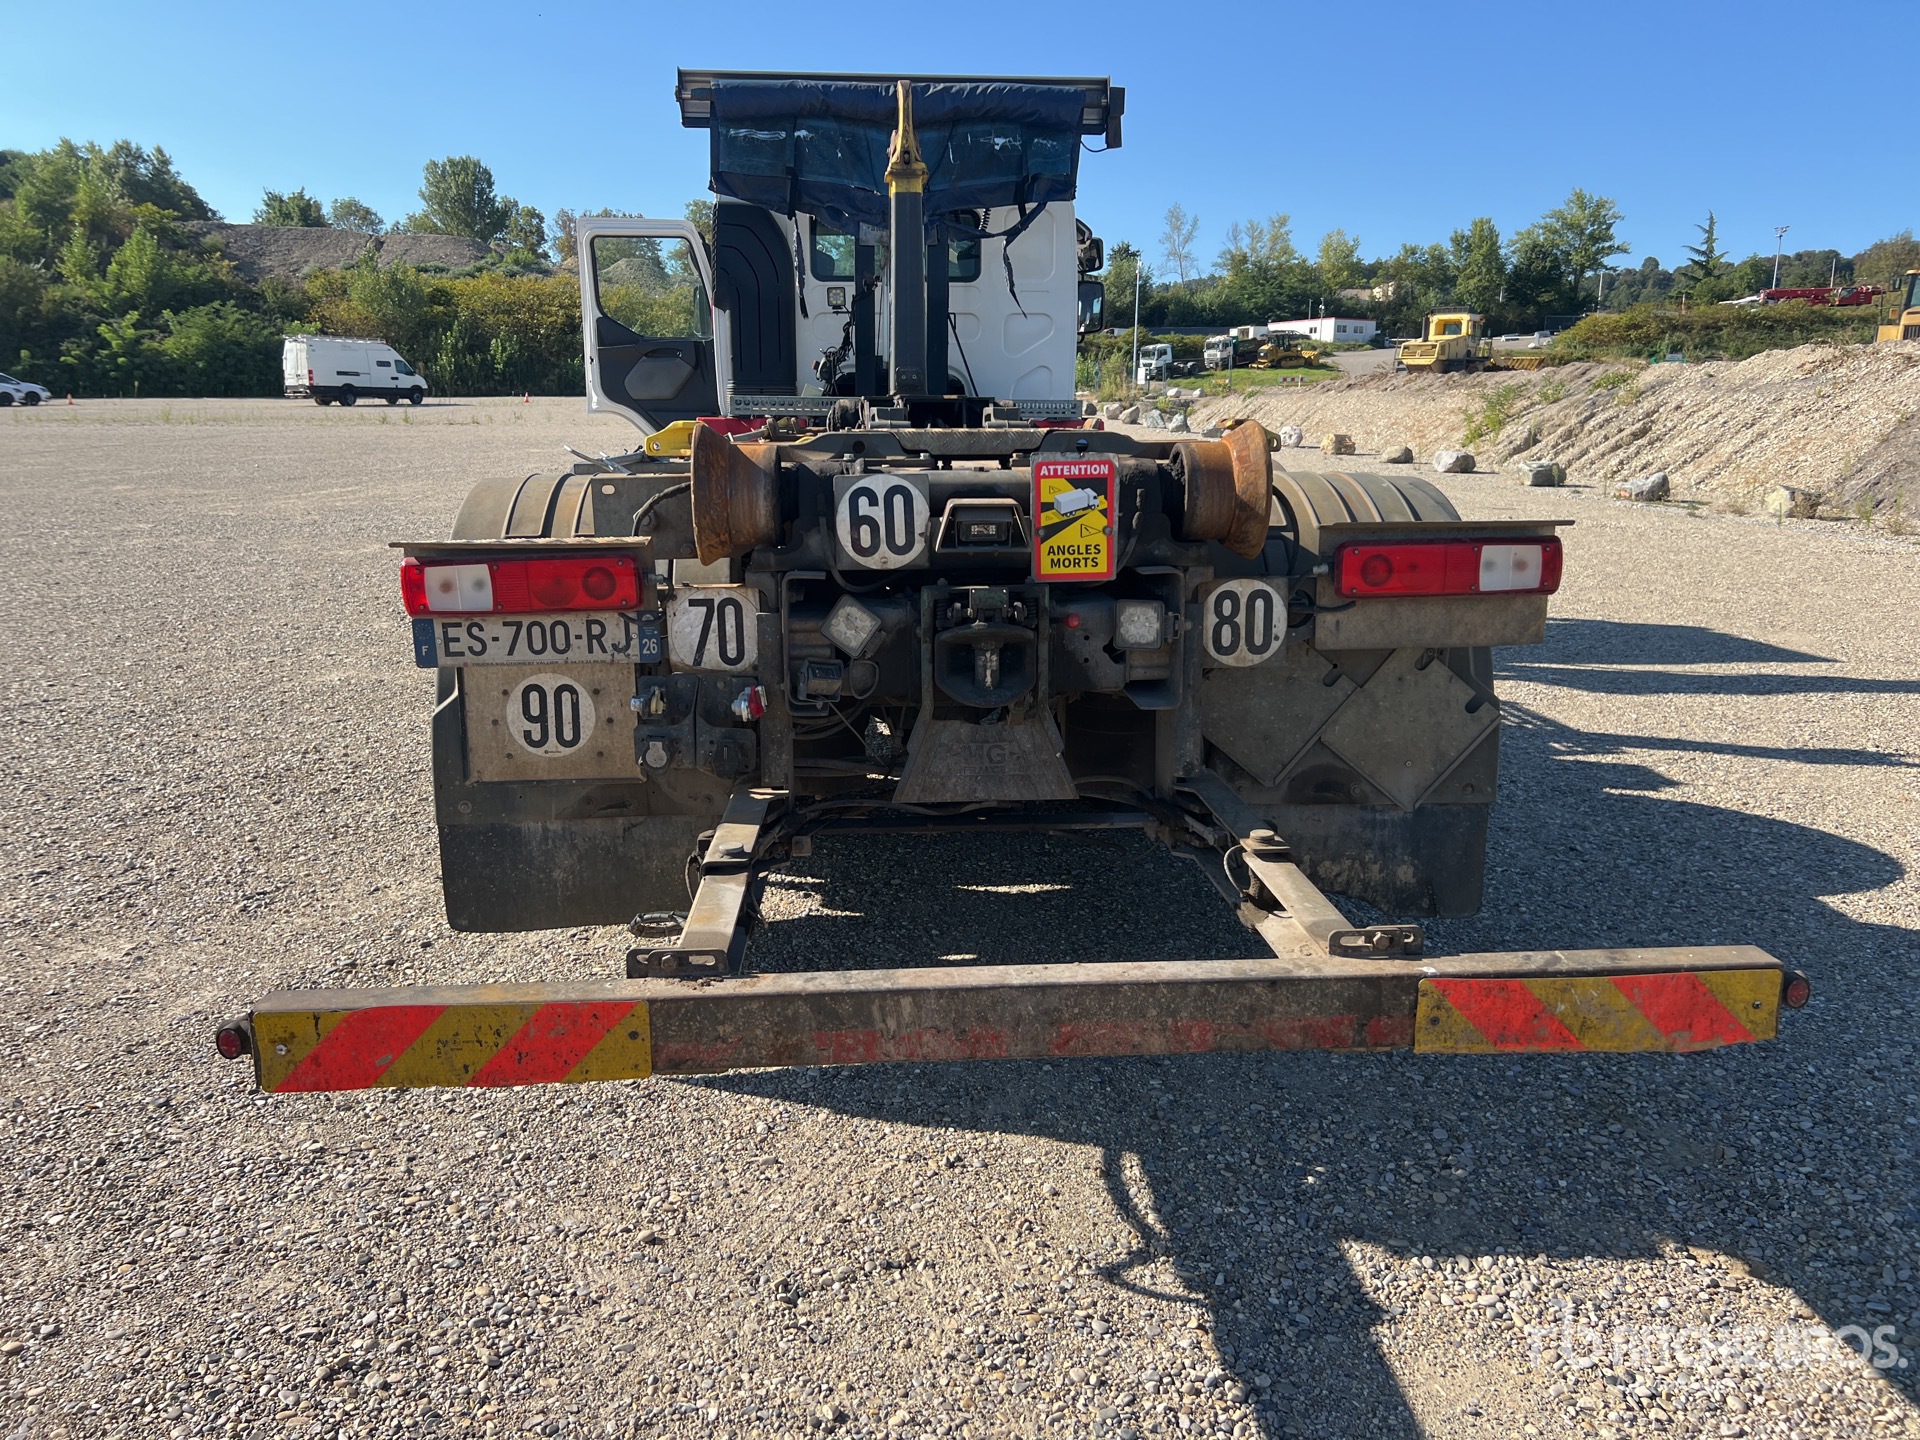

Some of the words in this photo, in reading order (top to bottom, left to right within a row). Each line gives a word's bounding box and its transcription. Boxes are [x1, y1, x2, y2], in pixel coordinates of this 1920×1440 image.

[1040, 464, 1109, 476] ATTENTION
[848, 484, 916, 558] 60
[1047, 544, 1102, 557] ANGLES
[1050, 557, 1099, 569] MORTS
[688, 597, 744, 667] 70
[1212, 588, 1274, 656] 80
[421, 645, 429, 656] F
[442, 617, 633, 658] ES-700-RJ
[642, 638, 658, 655] 26
[521, 683, 581, 749] 90
